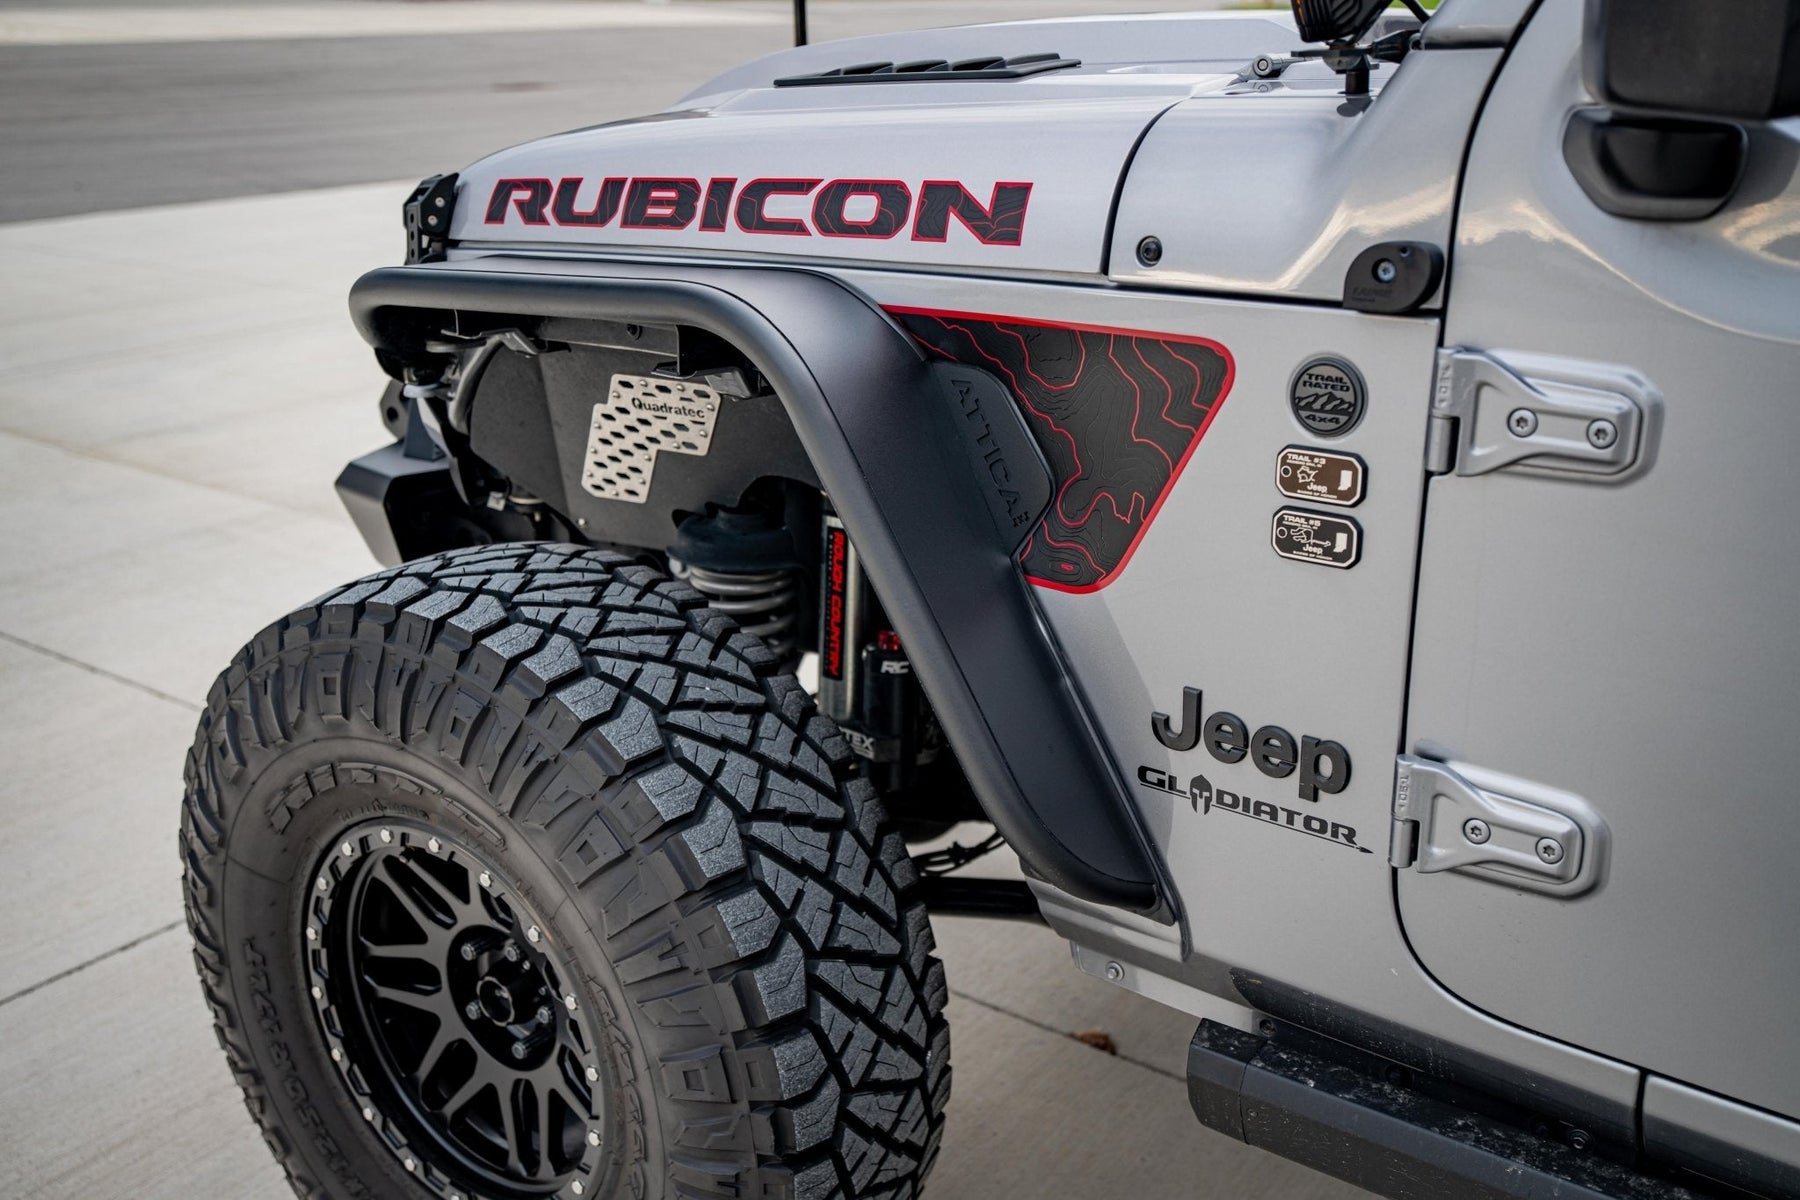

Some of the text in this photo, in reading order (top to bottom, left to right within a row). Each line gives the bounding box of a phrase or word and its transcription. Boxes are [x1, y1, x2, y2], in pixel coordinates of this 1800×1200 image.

[484, 176, 1034, 246] RUBICON
[1302, 379, 1351, 393] RATED
[1305, 372, 1347, 385] TRAIL
[631, 396, 706, 419] Quadratec
[951, 379, 1020, 518] ATTICA
[1286, 453, 1312, 463] TRAIL
[1306, 481, 1328, 494] Jeep
[1282, 514, 1308, 525] TRAIL
[1302, 543, 1323, 556] Jeep
[831, 530, 845, 592] ROUGH
[828, 596, 843, 677] COUNTRY
[1151, 686, 1352, 803] Jeep
